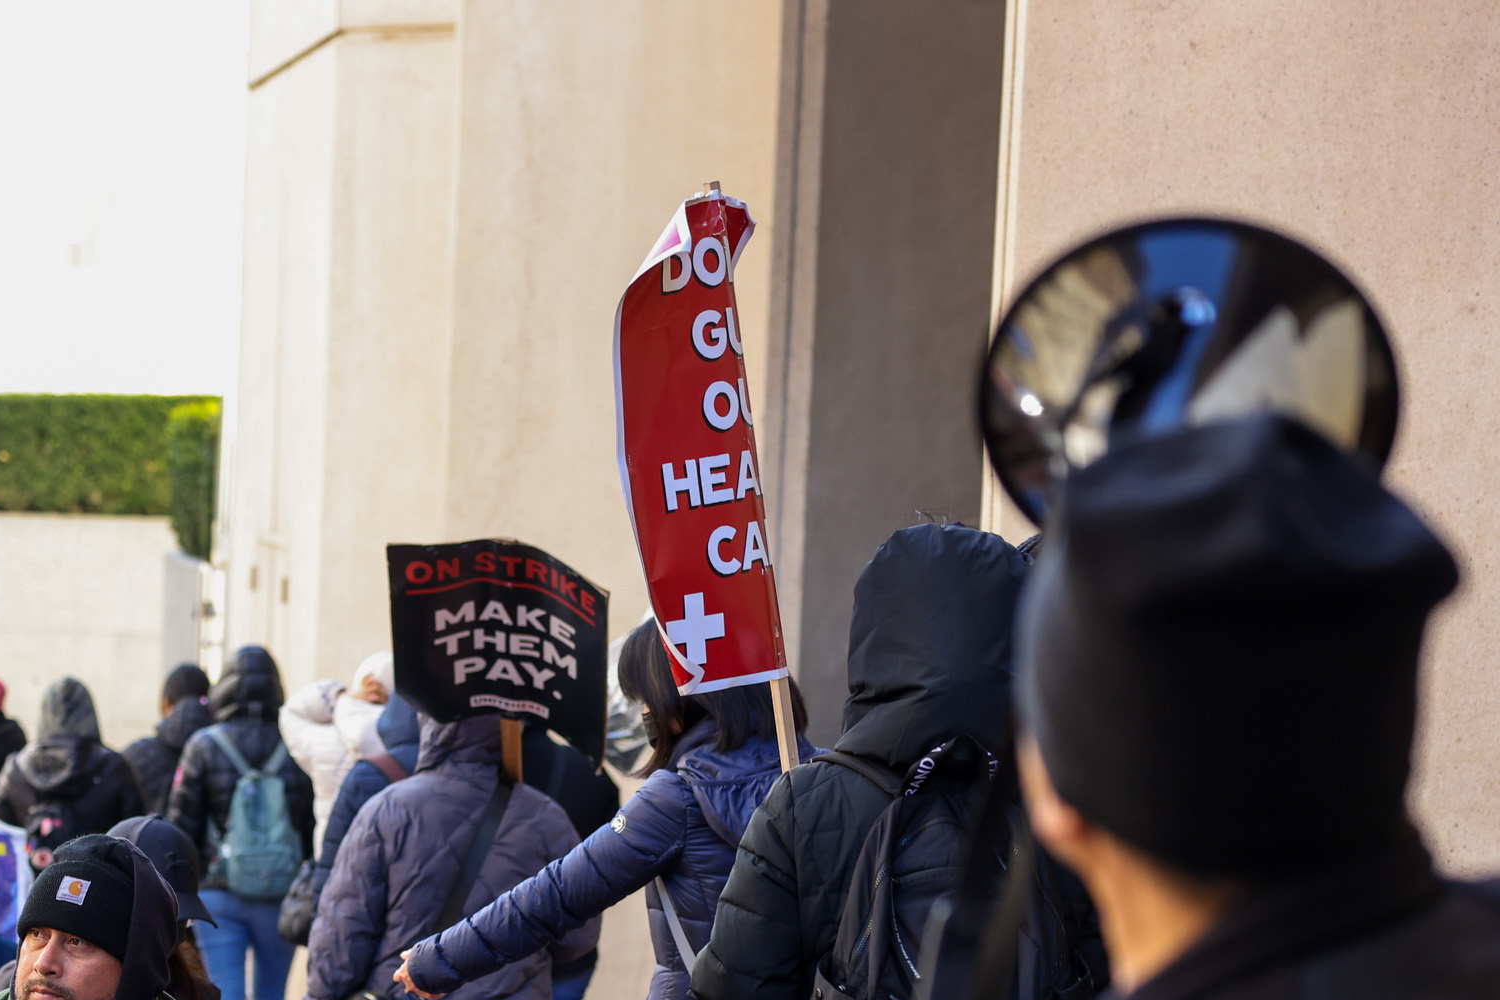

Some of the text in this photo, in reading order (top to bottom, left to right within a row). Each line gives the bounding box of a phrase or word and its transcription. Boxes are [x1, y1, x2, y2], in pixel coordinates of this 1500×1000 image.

[707, 518, 773, 575] CA
[405, 551, 596, 616] ON STRIKE
[434, 600, 576, 650] MAKE
[433, 628, 578, 680] THEM
[453, 656, 563, 701] PAY.
